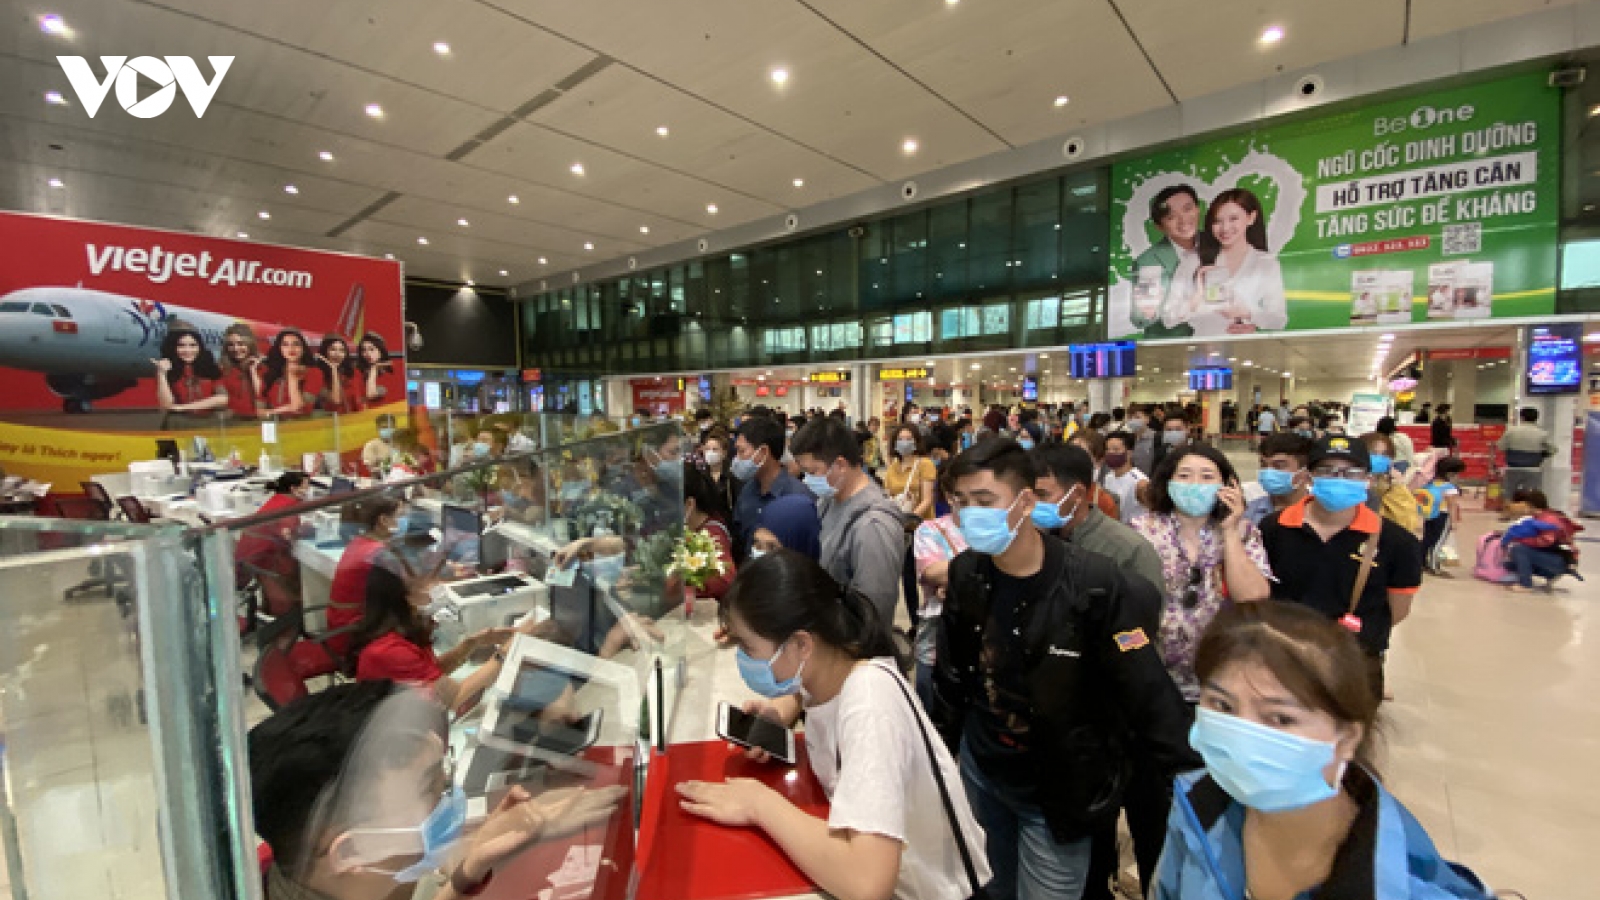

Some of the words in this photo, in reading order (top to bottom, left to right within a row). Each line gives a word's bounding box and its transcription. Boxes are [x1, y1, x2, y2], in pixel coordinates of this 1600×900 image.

[1360, 140, 1400, 171] CỐC
[1405, 134, 1456, 164] DINH
[1365, 177, 1406, 200] TRỢ
[1410, 169, 1468, 194] TĂNG
[1475, 161, 1522, 185] CÂN
[1315, 213, 1368, 239] TĂNG
[1373, 205, 1416, 231] SỨC
[1456, 190, 1537, 220] KHÁNG
